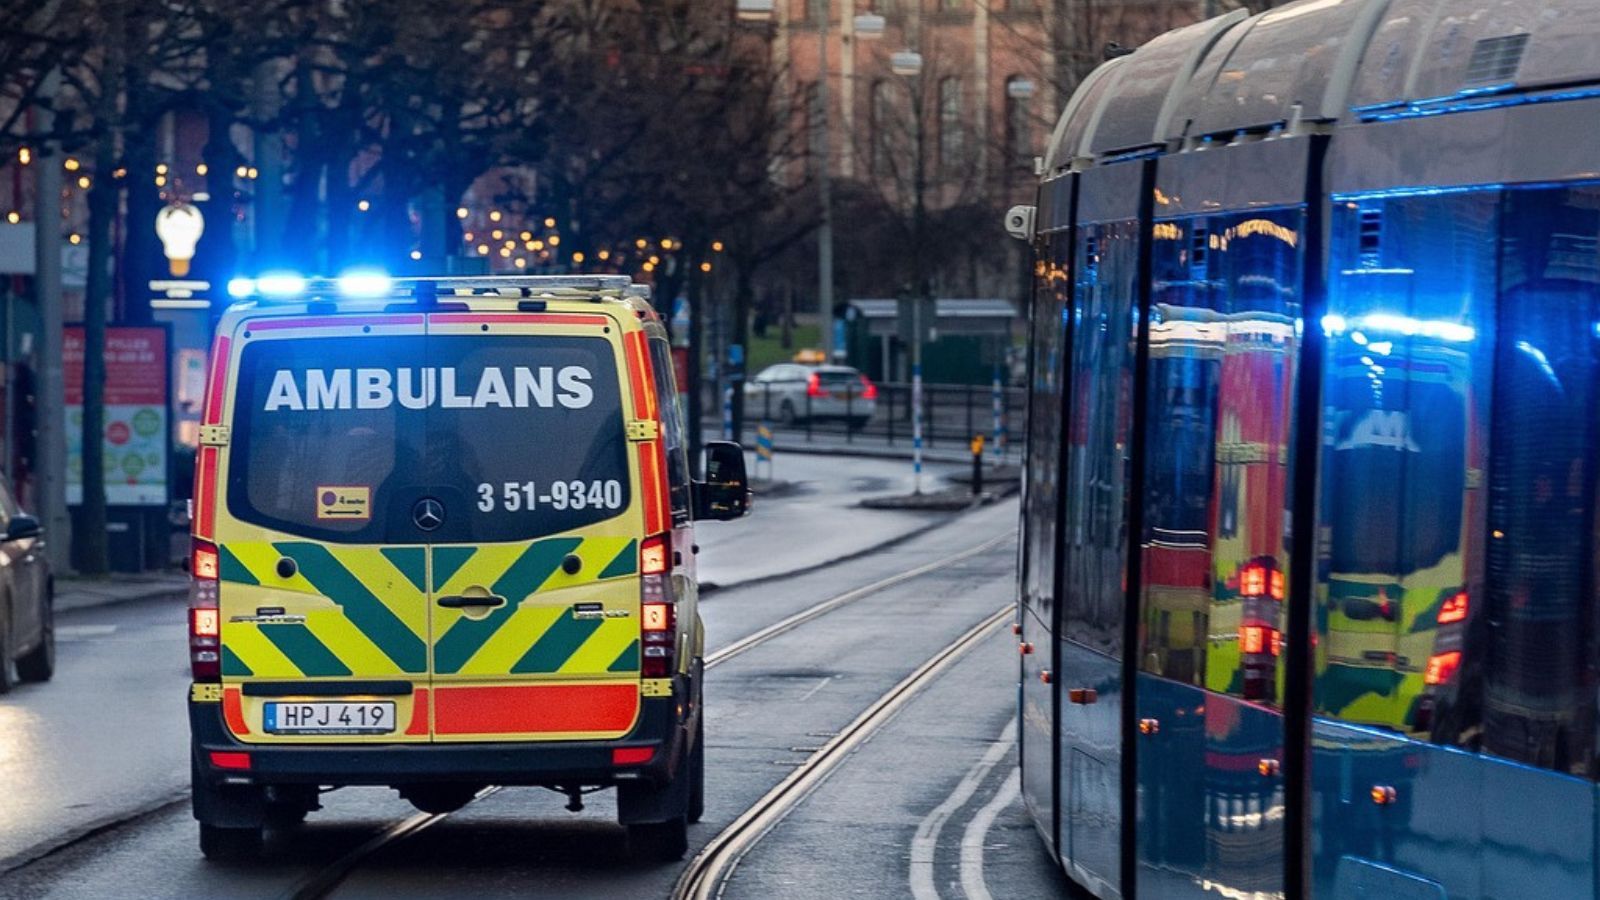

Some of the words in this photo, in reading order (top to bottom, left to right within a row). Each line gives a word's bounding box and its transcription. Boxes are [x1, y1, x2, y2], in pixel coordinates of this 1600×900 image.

[264, 366, 594, 411] AMBULANS
[477, 482, 495, 512] 3
[504, 480, 622, 511] 51-9340
[285, 706, 330, 726] HPJ
[337, 706, 385, 726] 419
